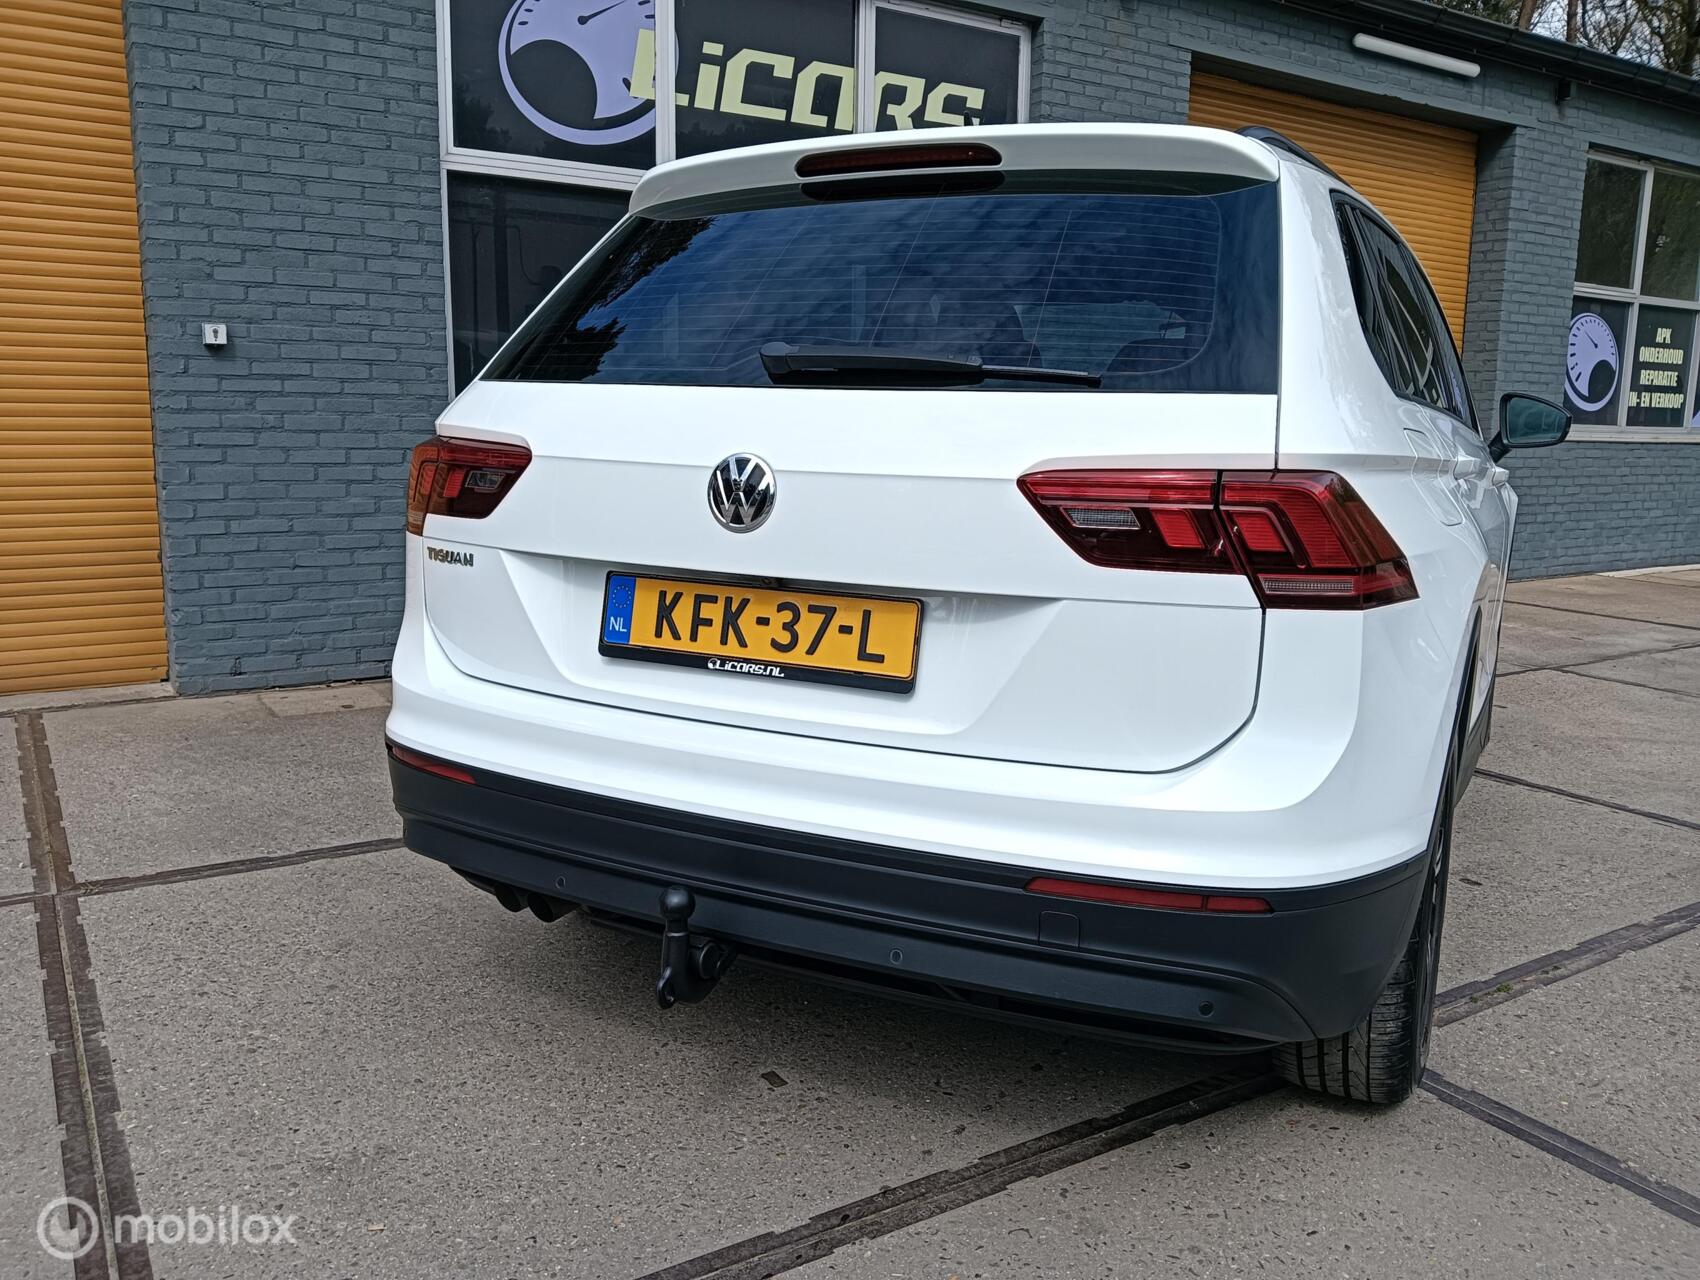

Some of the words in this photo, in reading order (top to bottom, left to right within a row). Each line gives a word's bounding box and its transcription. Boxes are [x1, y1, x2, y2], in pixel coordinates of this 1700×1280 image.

[1655, 327, 1672, 343] APK
[1639, 346, 1684, 364] ONDERHOUD
[1640, 369, 1679, 387] REPARATIE
[1628, 391, 1640, 407] IN-
[1640, 392, 1651, 408] EN
[1651, 393, 1684, 409] VERKOOP
[427, 546, 474, 567] TIGUAN
[609, 616, 628, 633] NL
[654, 589, 886, 664] KFK-37-L
